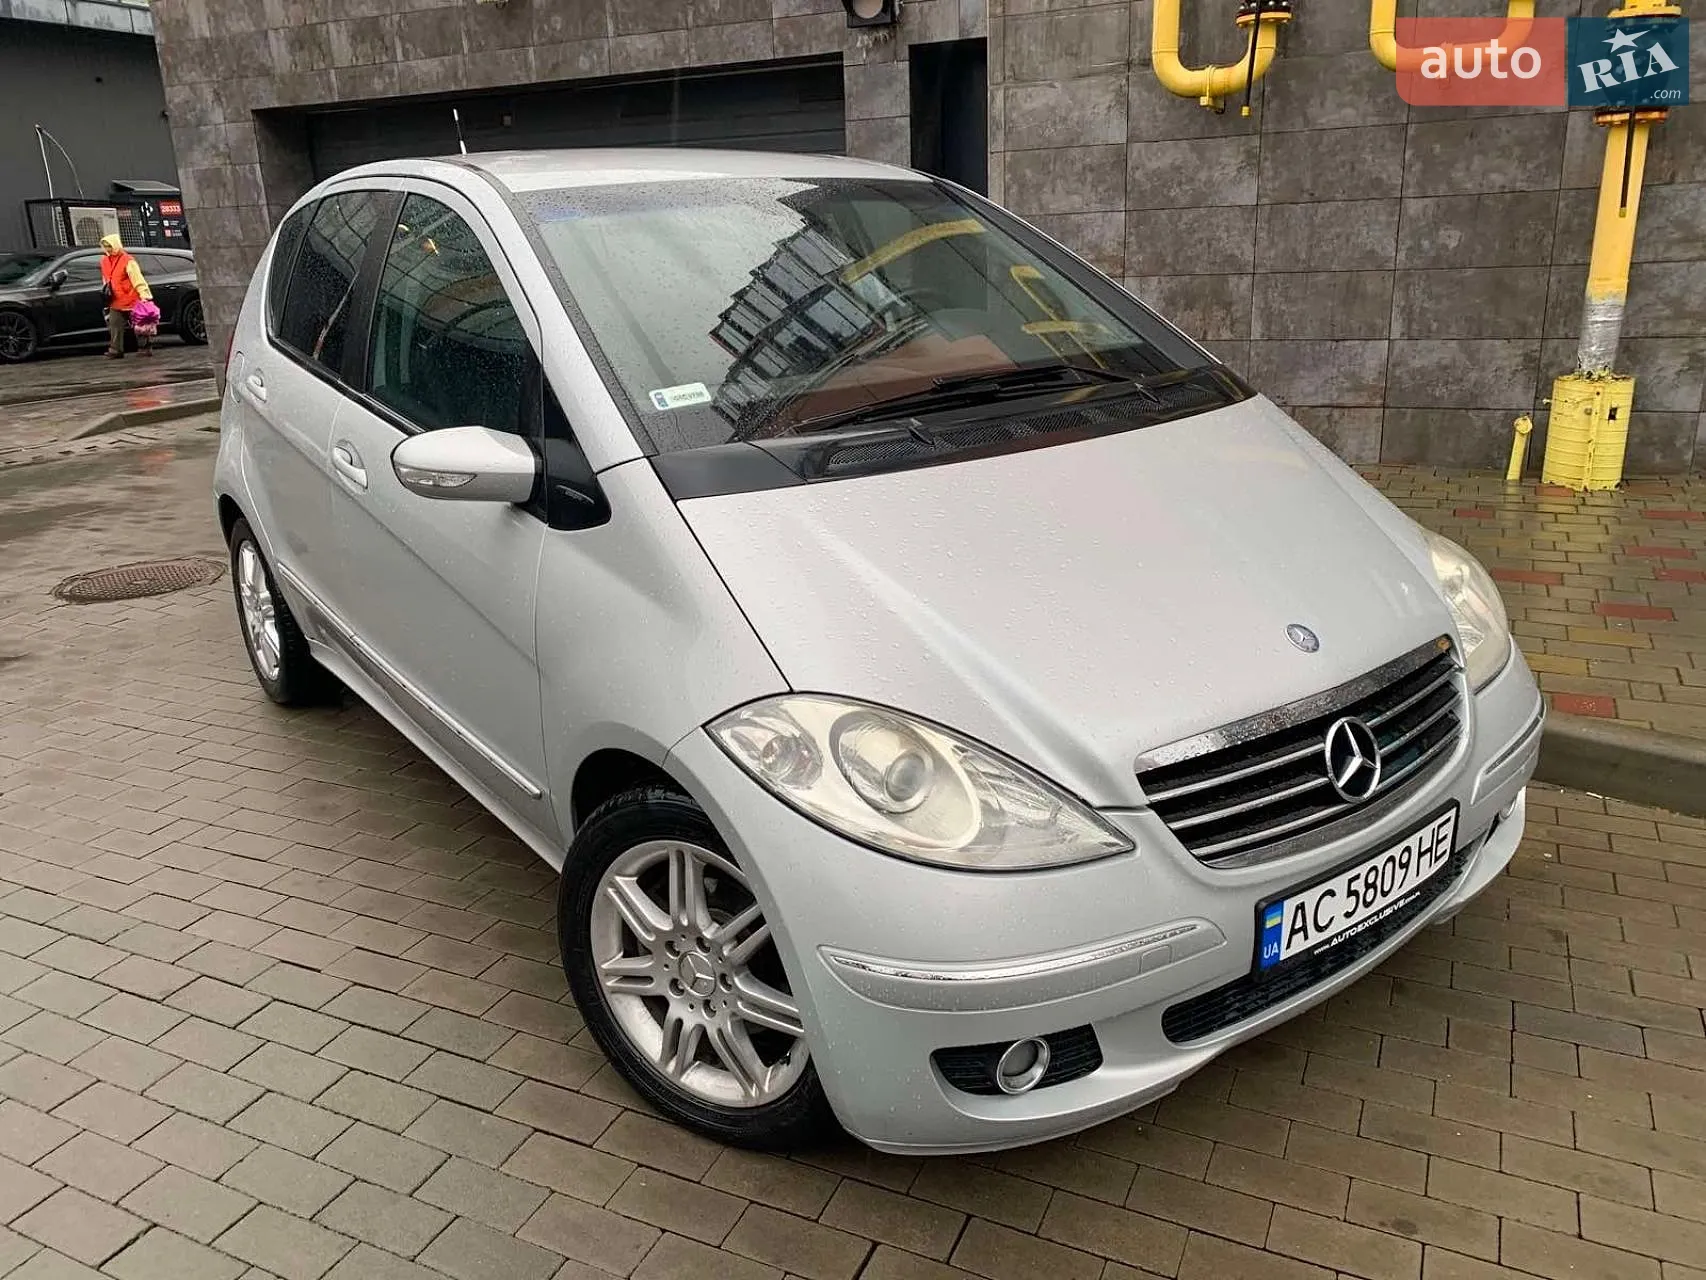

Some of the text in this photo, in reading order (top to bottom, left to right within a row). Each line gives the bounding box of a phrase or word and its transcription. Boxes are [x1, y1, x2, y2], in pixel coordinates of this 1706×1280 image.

[1285, 815, 1452, 951] AC 5809 HE
[1263, 941, 1280, 959] UA
